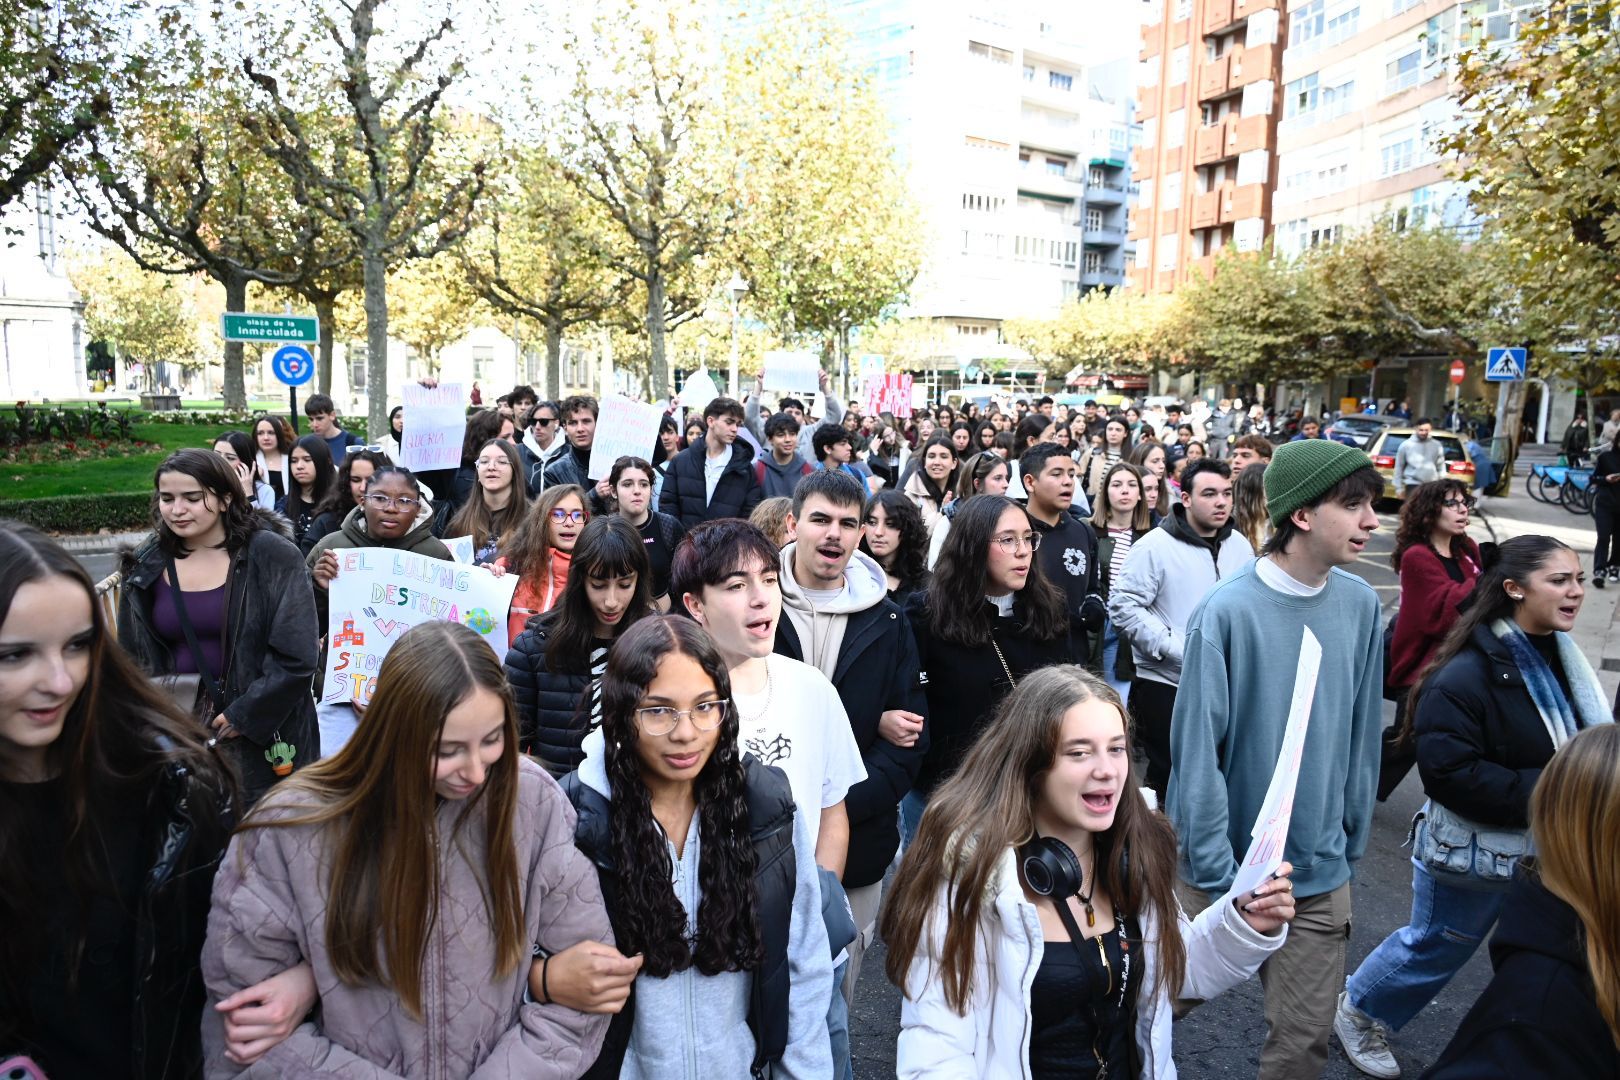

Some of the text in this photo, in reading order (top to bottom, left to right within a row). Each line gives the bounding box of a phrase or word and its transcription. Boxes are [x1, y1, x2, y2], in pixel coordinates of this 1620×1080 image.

[238, 326, 304, 337] Inmaculada
[344, 552, 373, 571] EL
[371, 583, 460, 624] DESTROZA
[325, 672, 378, 702] STO
